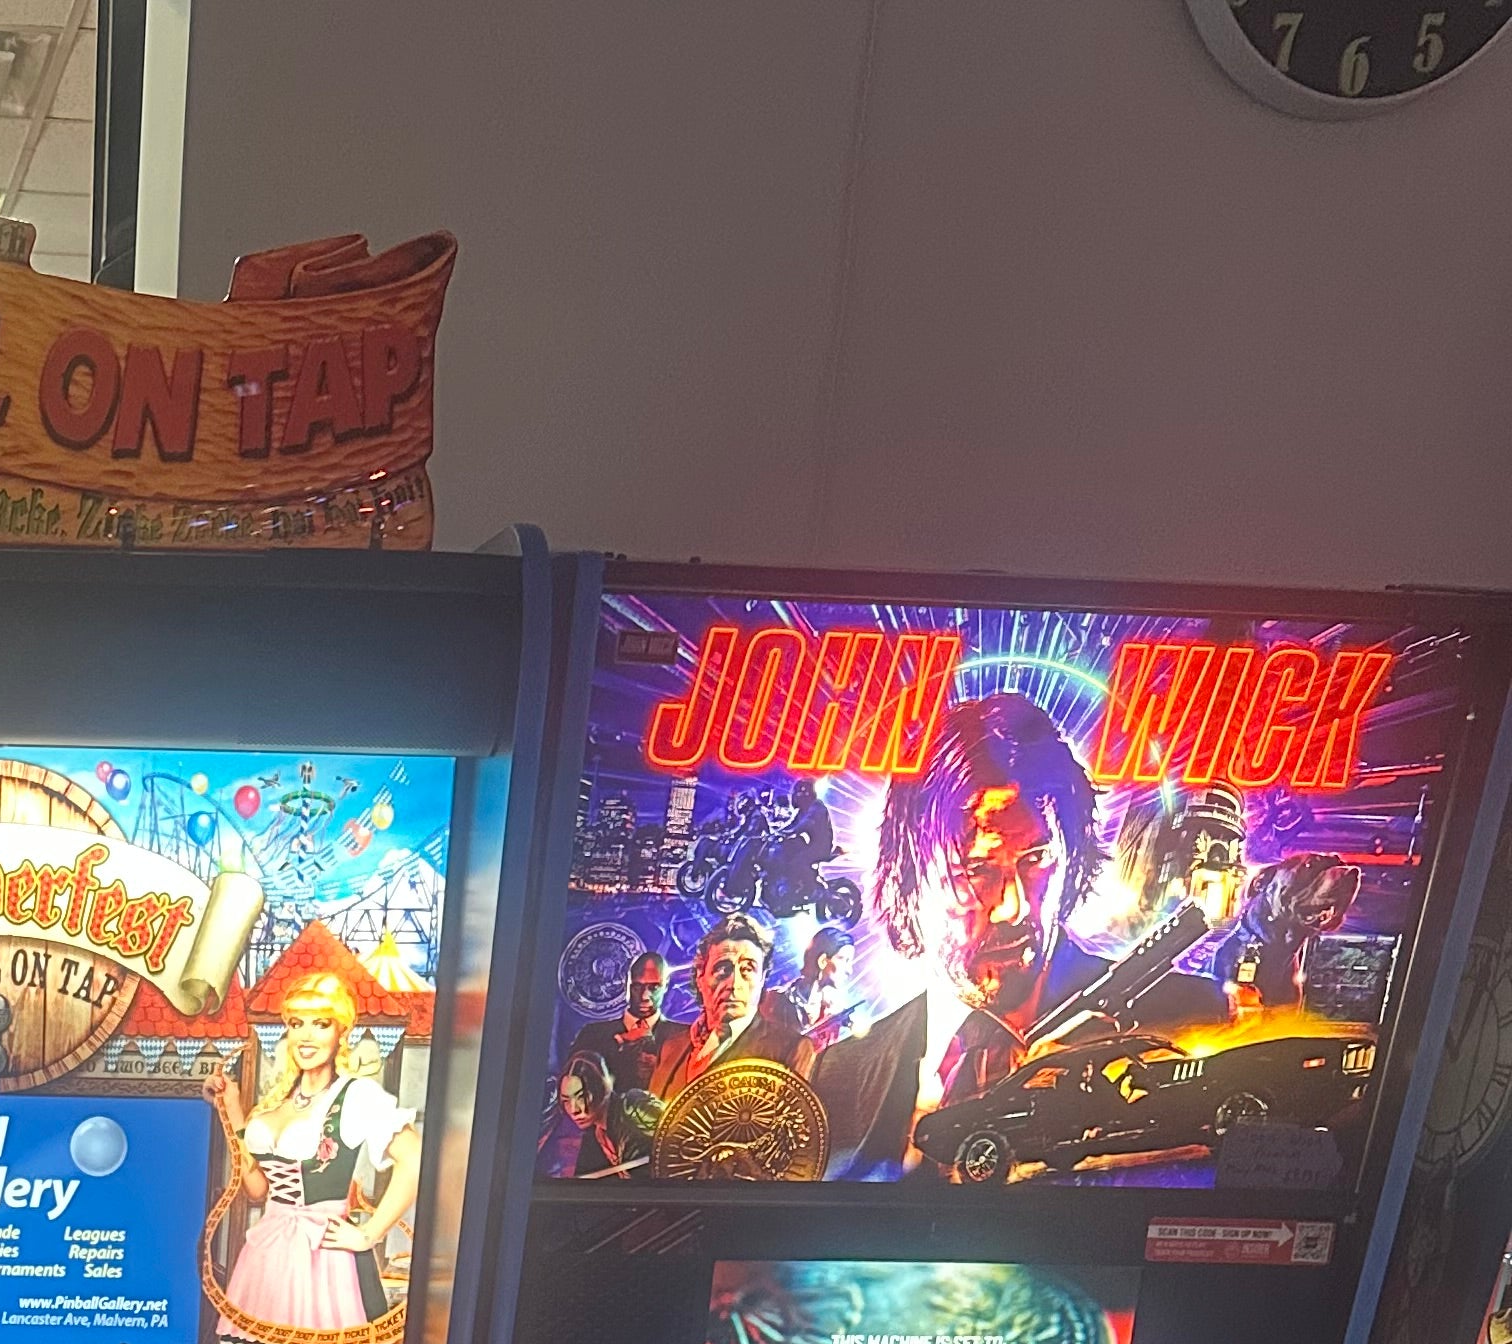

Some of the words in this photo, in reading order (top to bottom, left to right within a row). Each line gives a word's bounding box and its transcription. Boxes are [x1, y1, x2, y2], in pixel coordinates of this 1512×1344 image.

[1273, 13, 1303, 72] 7
[1412, 12, 1446, 73] 5
[1340, 36, 1371, 97] 6
[39, 329, 201, 461] ON
[229, 325, 426, 459] TAP
[647, 627, 962, 775] JOHN
[1091, 642, 1393, 788] WICK
[10, 948, 47, 989] ON
[58, 958, 124, 1012] TAP
[64, 1226, 126, 1244] Leagues
[1158, 1228, 1178, 1237] SCAN
[69, 1244, 125, 1261] Repairs
[84, 1262, 123, 1279] Sales
[1, 1312, 63, 1326] Lancaster
[64, 1314, 90, 1328] Ave,
[93, 1314, 148, 1329] Malvern,
[151, 1314, 169, 1328] PA
[19, 1295, 168, 1313] www.PinballGallery.net
